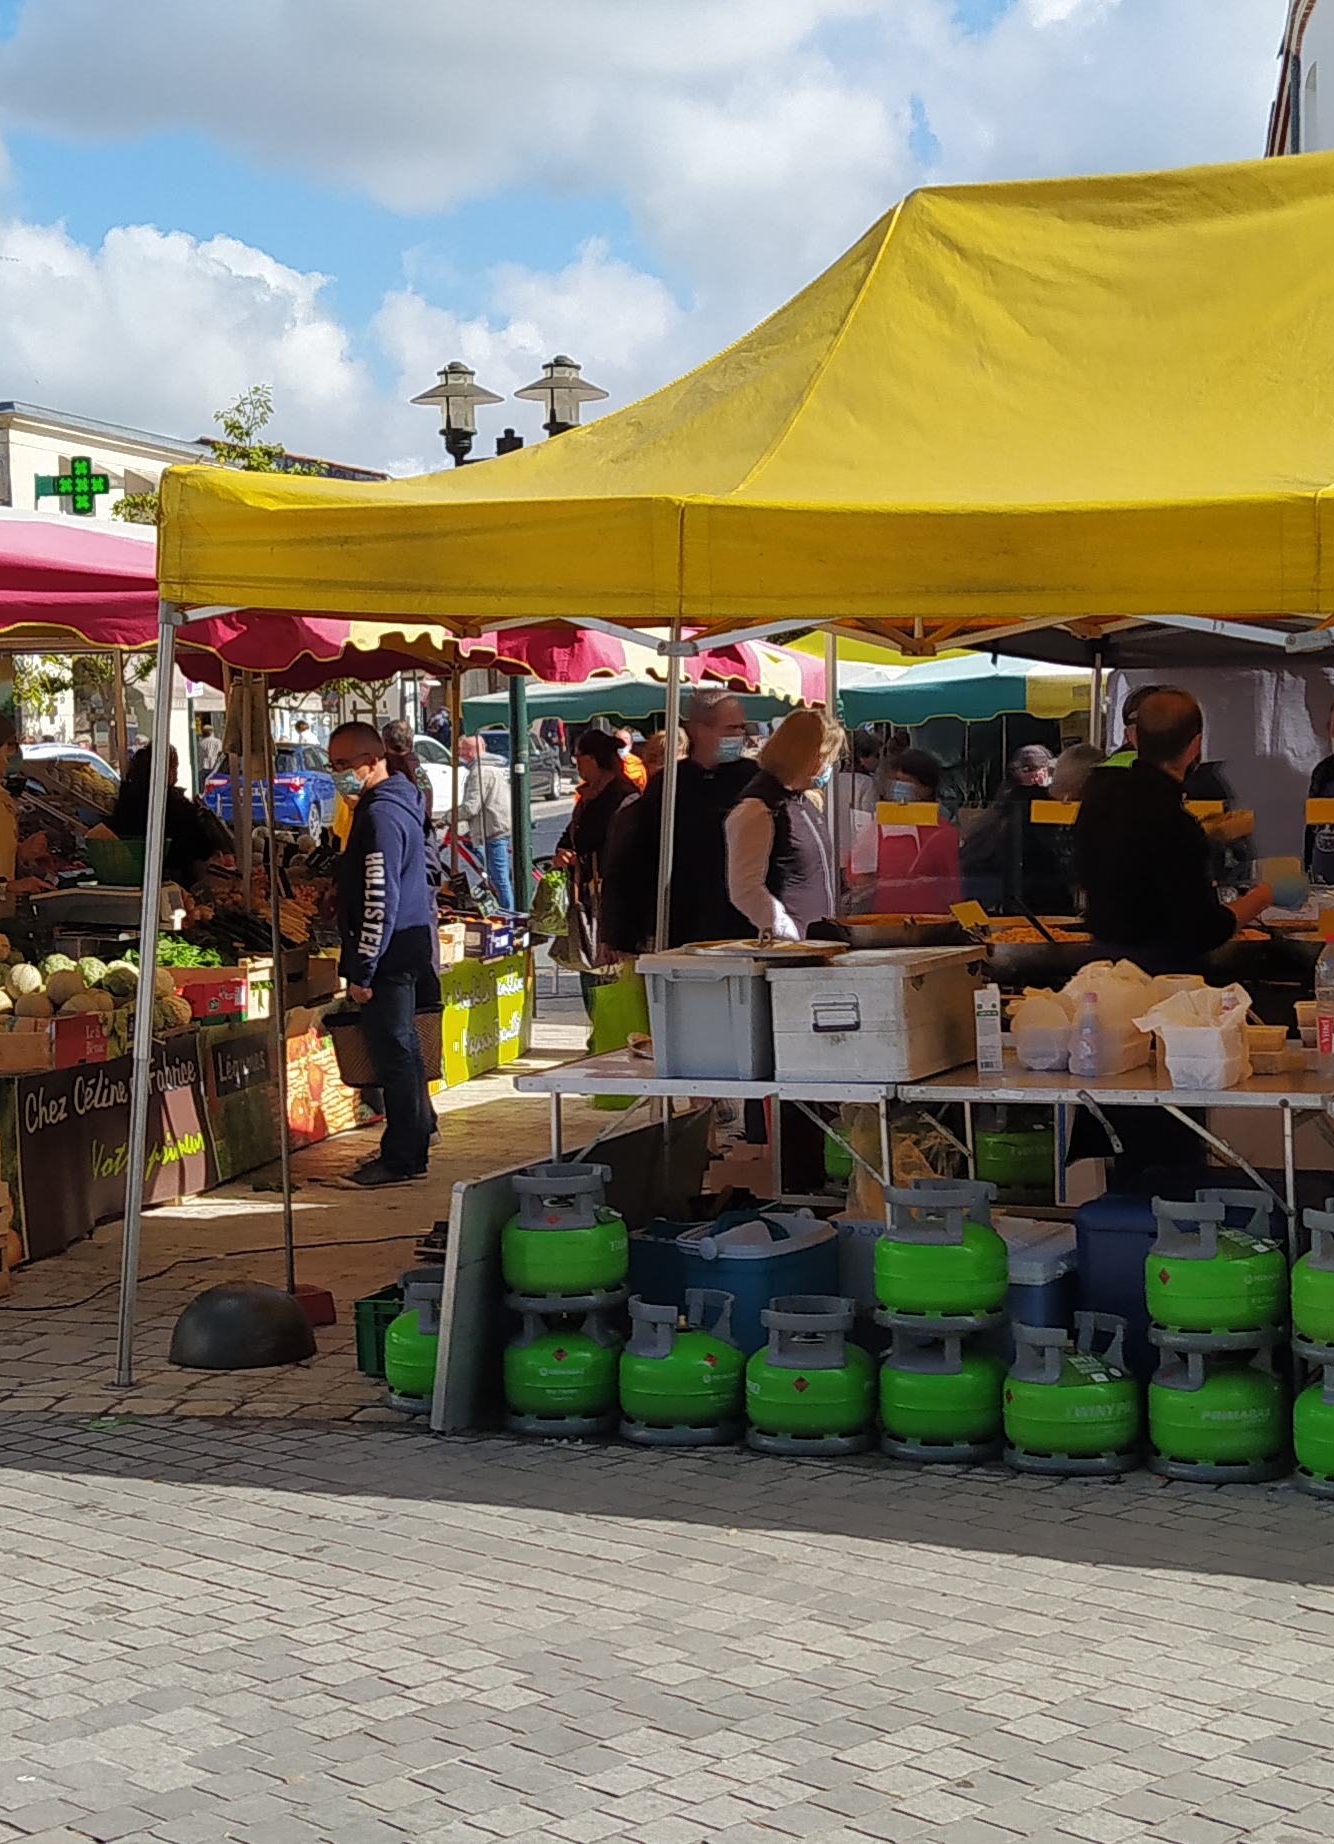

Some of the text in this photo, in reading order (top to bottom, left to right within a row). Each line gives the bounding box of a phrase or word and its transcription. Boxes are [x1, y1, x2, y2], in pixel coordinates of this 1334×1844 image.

[357, 851, 386, 958] HOLLISTER
[25, 1050, 196, 1134] Chez Céline Fabrice
